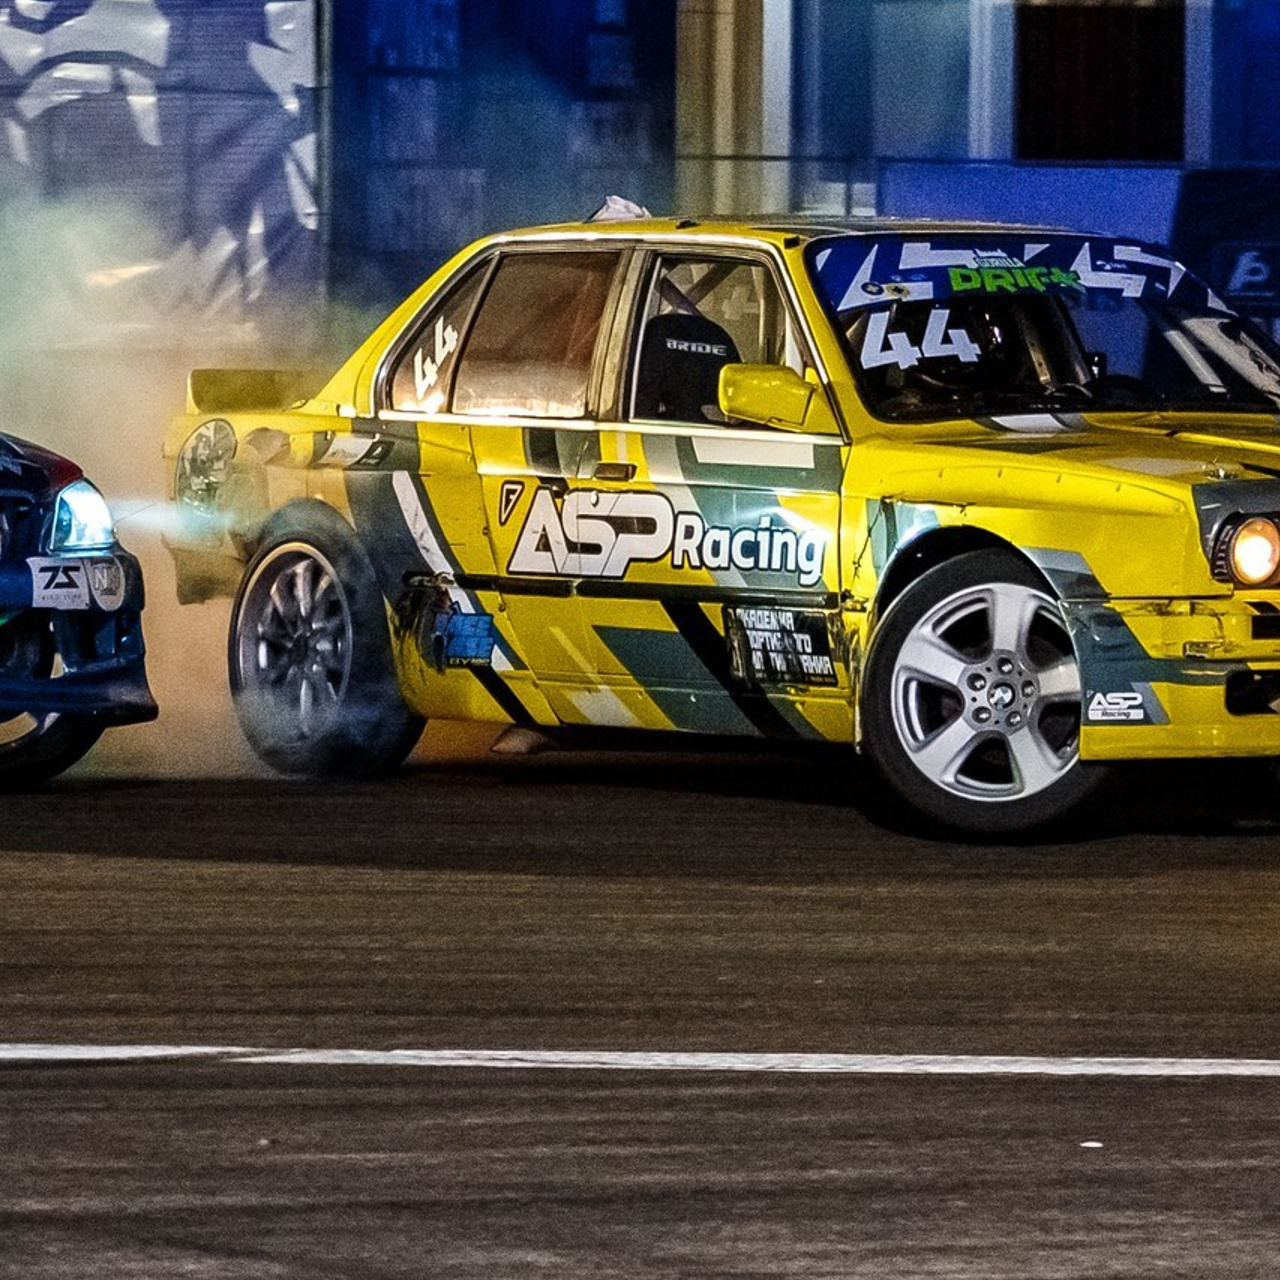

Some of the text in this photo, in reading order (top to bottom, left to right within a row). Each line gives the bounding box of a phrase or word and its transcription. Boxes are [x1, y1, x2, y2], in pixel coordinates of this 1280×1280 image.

[414, 315, 458, 402] 44
[665, 338, 727, 356] BRIDE
[860, 308, 982, 370] 44
[507, 487, 827, 588] ASP Racing
[1089, 691, 1144, 709] ASP
